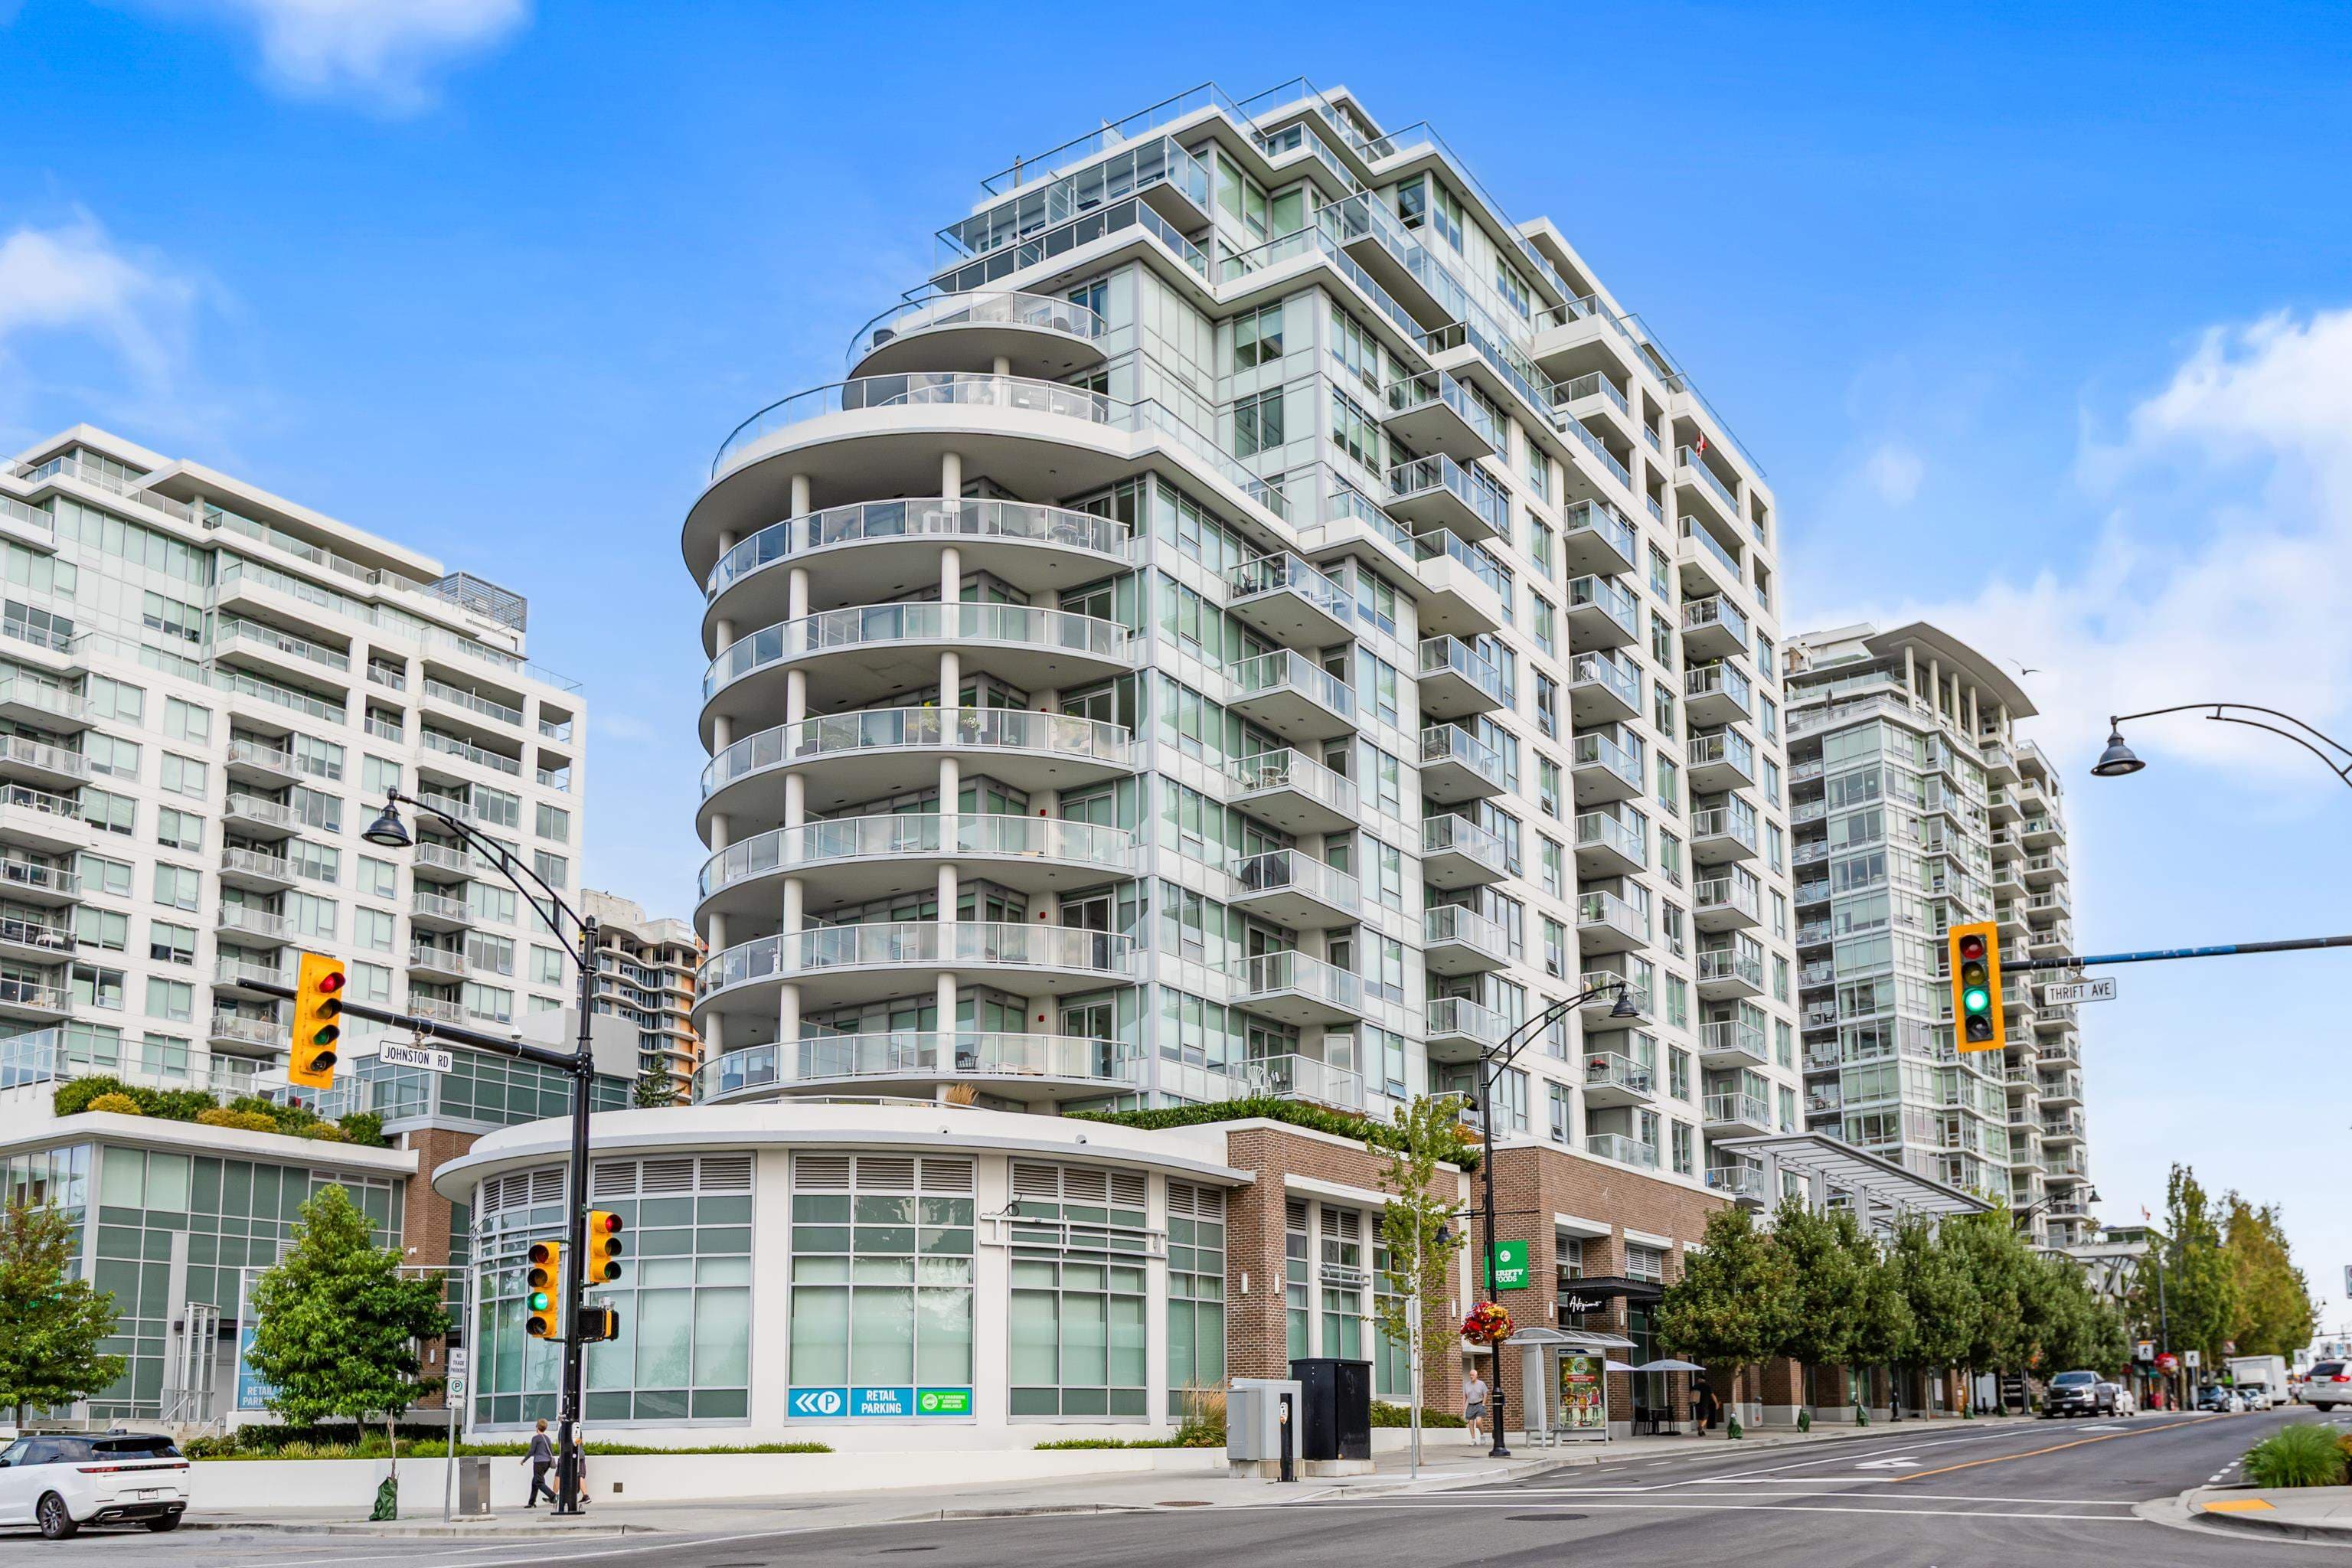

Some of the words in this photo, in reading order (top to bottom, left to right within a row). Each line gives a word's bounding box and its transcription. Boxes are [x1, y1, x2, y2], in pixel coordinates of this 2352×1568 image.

[2050, 985, 2084, 1001] THRIFT
[2092, 982, 2111, 997] AVE
[384, 1047, 430, 1065] JOHNSTON
[437, 1055, 449, 1068] RD
[247, 1386, 274, 1396] RETAIL
[866, 1390, 897, 1401] RETAIL
[861, 1403, 902, 1414] PARKING
